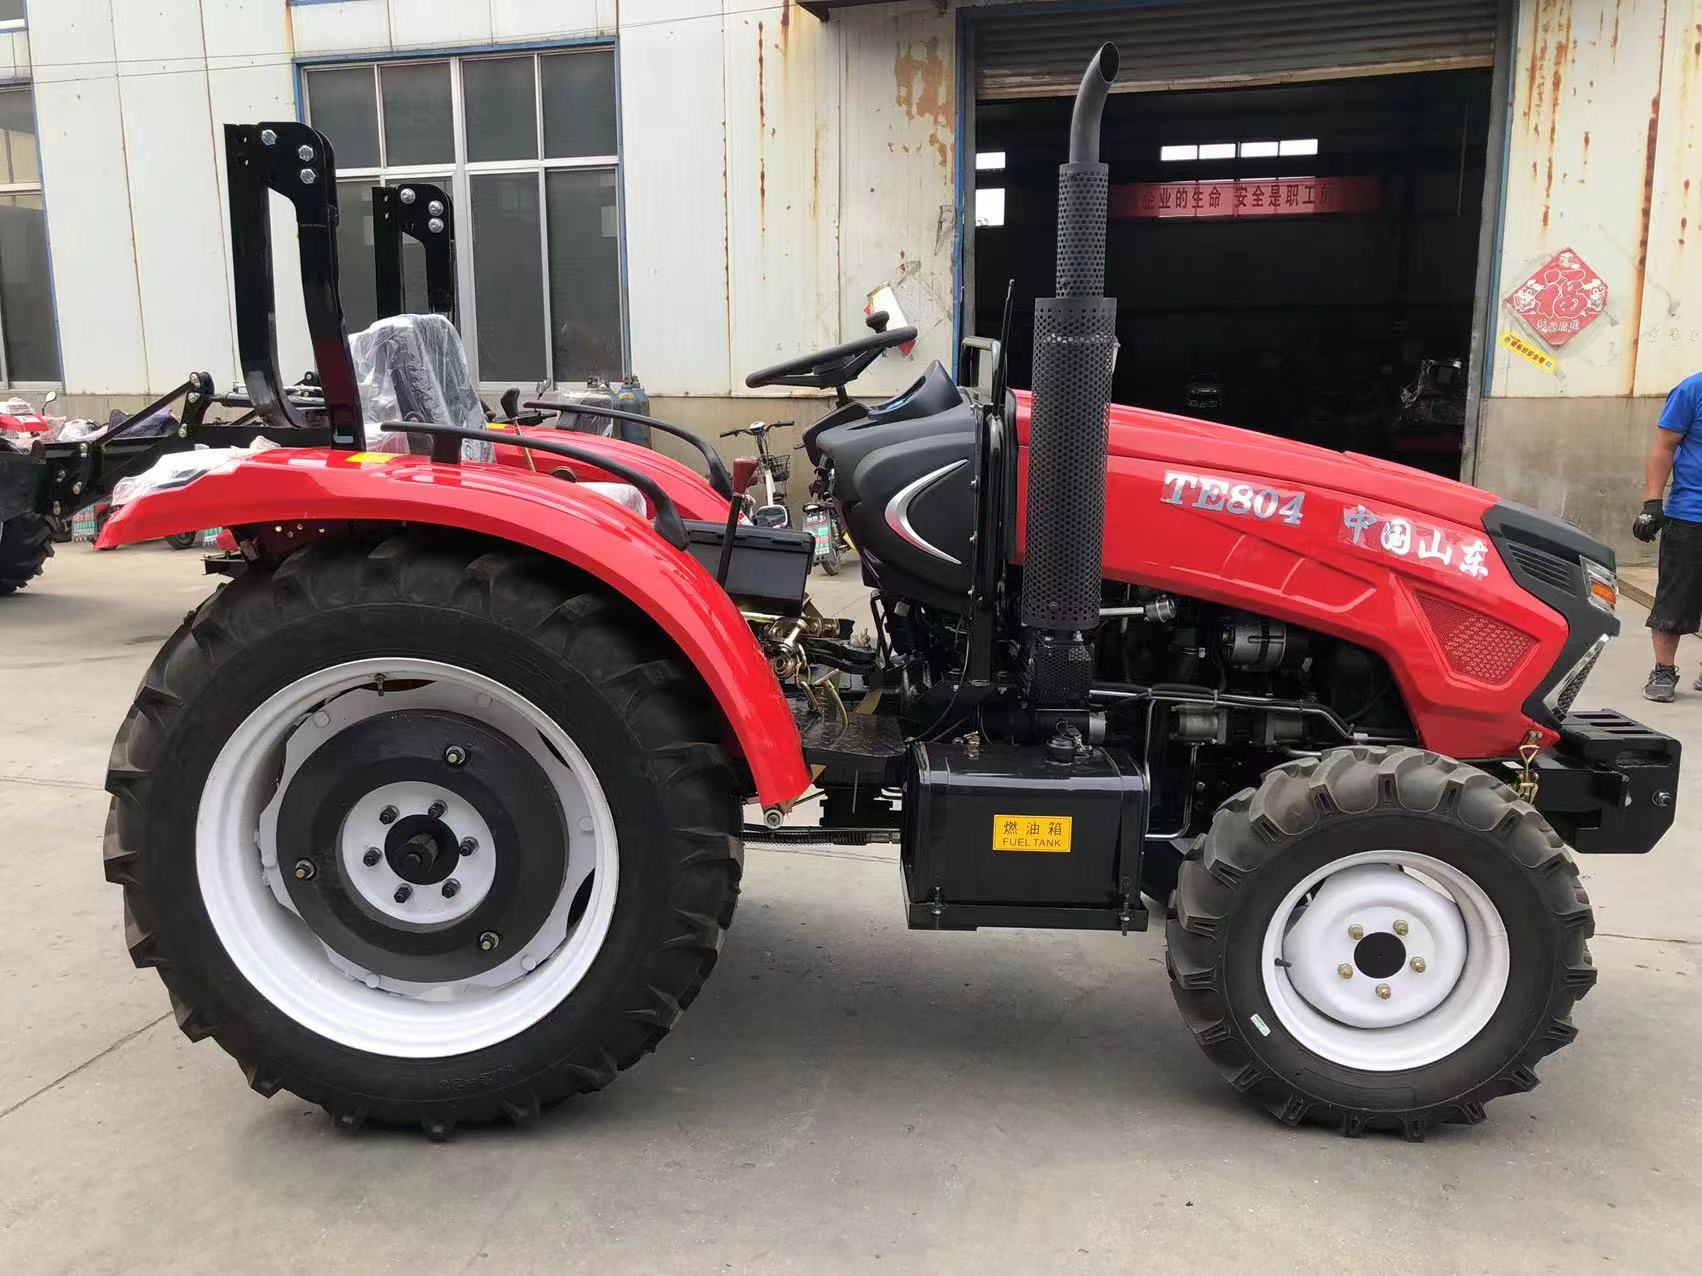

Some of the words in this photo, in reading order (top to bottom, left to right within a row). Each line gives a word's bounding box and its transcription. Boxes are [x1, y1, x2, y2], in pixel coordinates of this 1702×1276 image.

[1143, 185, 1222, 210] 企业的生命
[1534, 268, 1589, 319] 福
[1160, 471, 1306, 525] TE804
[1343, 503, 1489, 577] 中国山东
[1002, 837, 1031, 847] FUEL
[1033, 838, 1061, 847] TANK
[1003, 820, 1062, 836] 燃油箱
